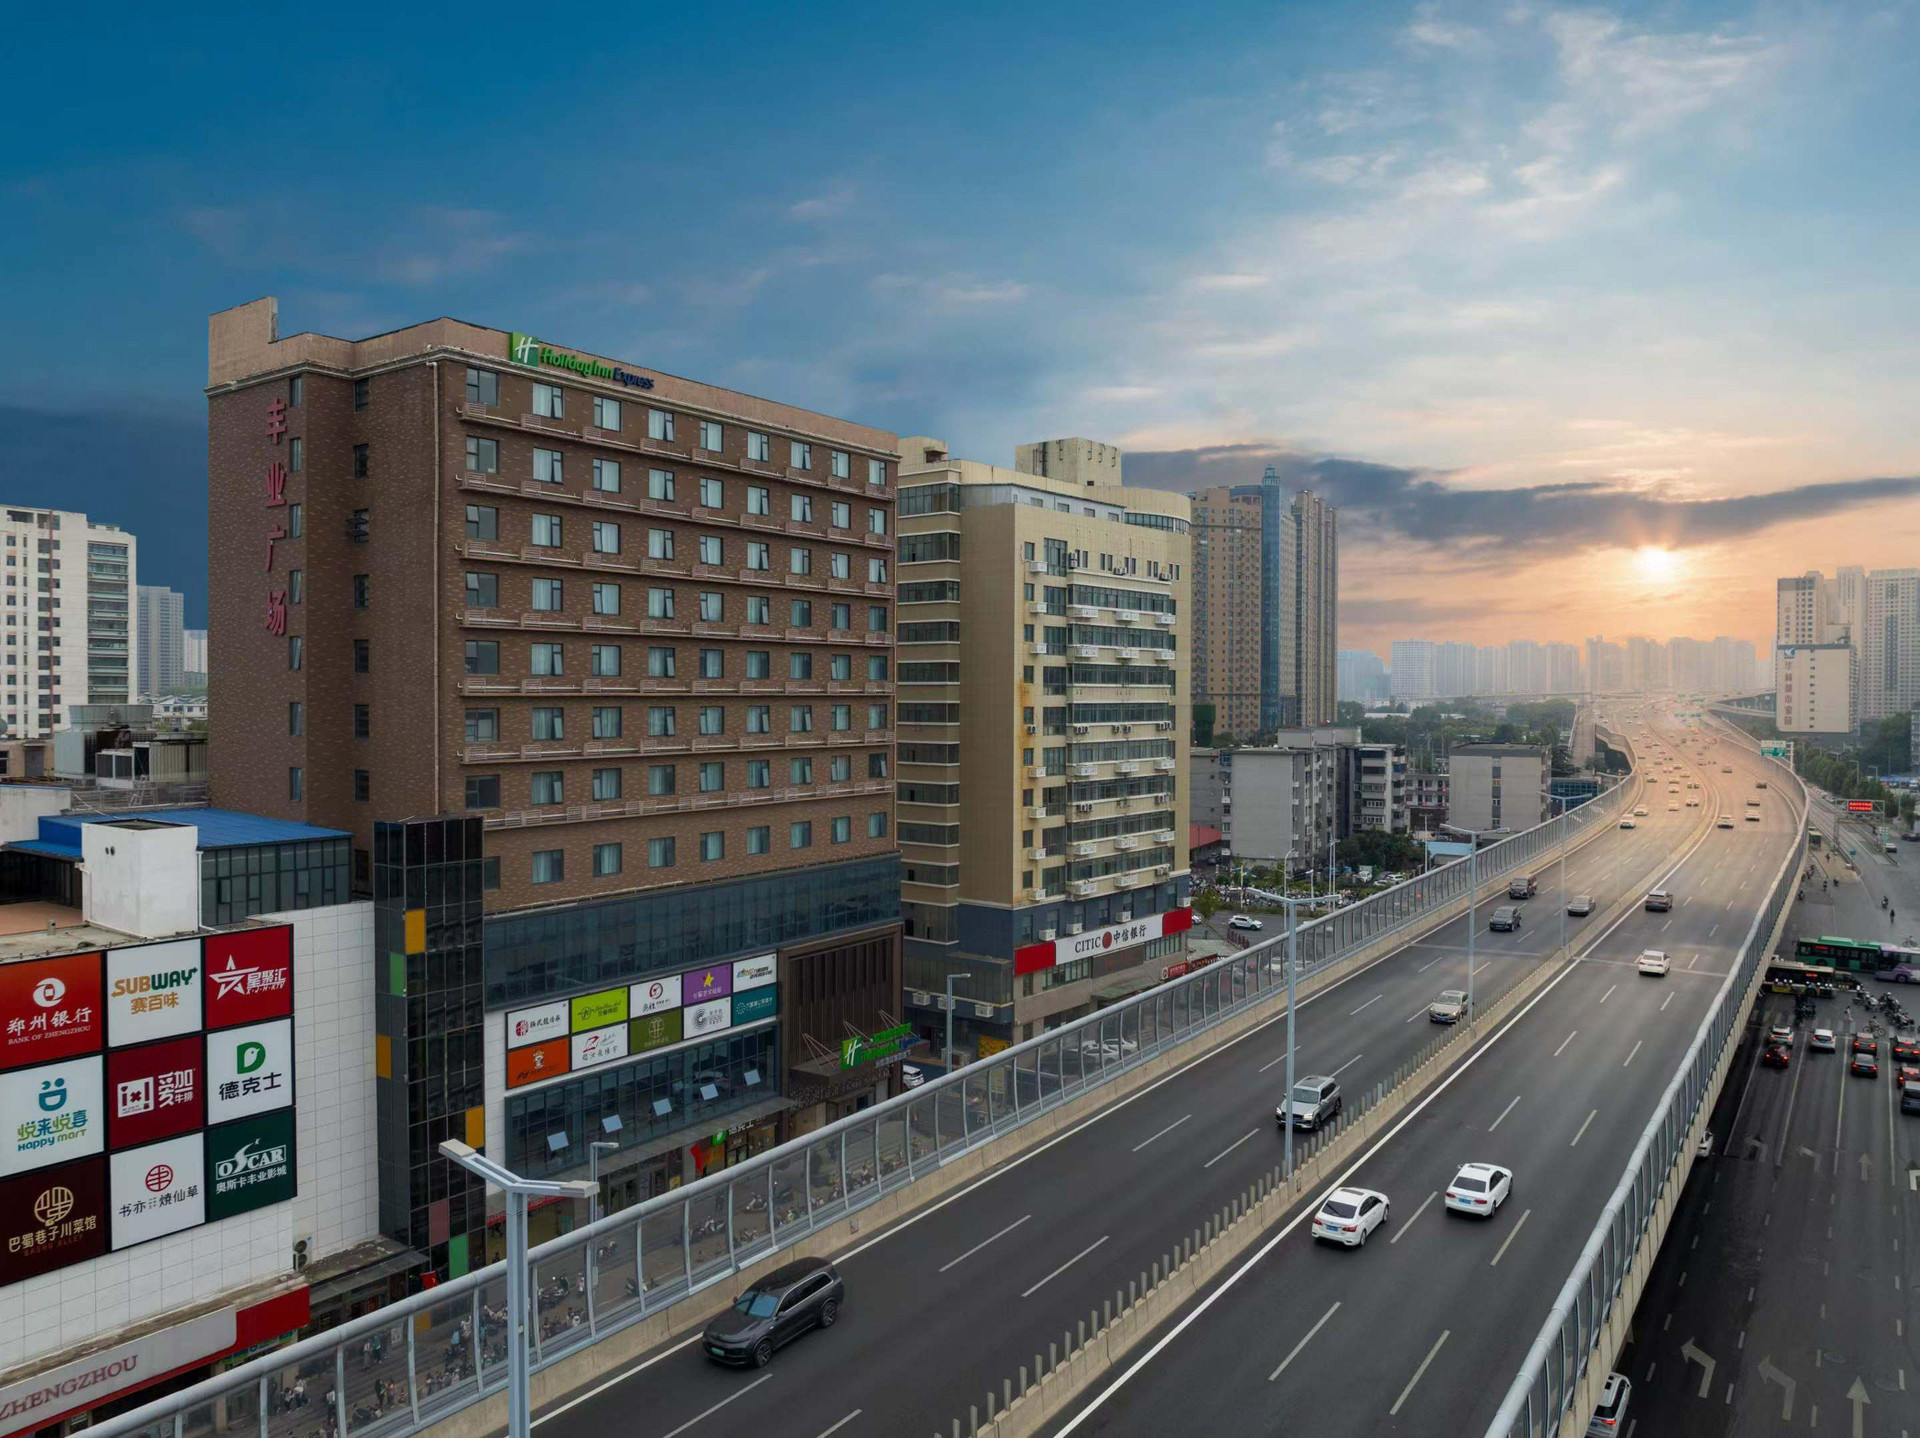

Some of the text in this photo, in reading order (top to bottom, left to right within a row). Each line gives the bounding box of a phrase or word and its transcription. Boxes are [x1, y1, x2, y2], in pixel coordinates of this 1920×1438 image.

[541, 346, 593, 377] Holiday
[592, 359, 614, 380] Inn
[612, 365, 655, 389] Express
[265, 397, 288, 636] 丰业广场
[1075, 923, 1147, 953] CITIC 中信银行
[111, 966, 198, 998] SUBWAY
[130, 991, 179, 1015] 赛百味
[6, 1006, 92, 1037] 郑州银行
[8, 1025, 91, 1045] BANK OF ZHENGZHOU
[219, 1071, 282, 1101] 德克士
[17, 1109, 88, 1142] 悦来悦喜
[218, 1142, 284, 1177] OSCAR
[215, 1164, 287, 1195] 奥斯卡丰业影城
[8, 1215, 97, 1253] 巴蜀巷子川菜馆
[0, 1354, 138, 1420] ZHENGZHOU
